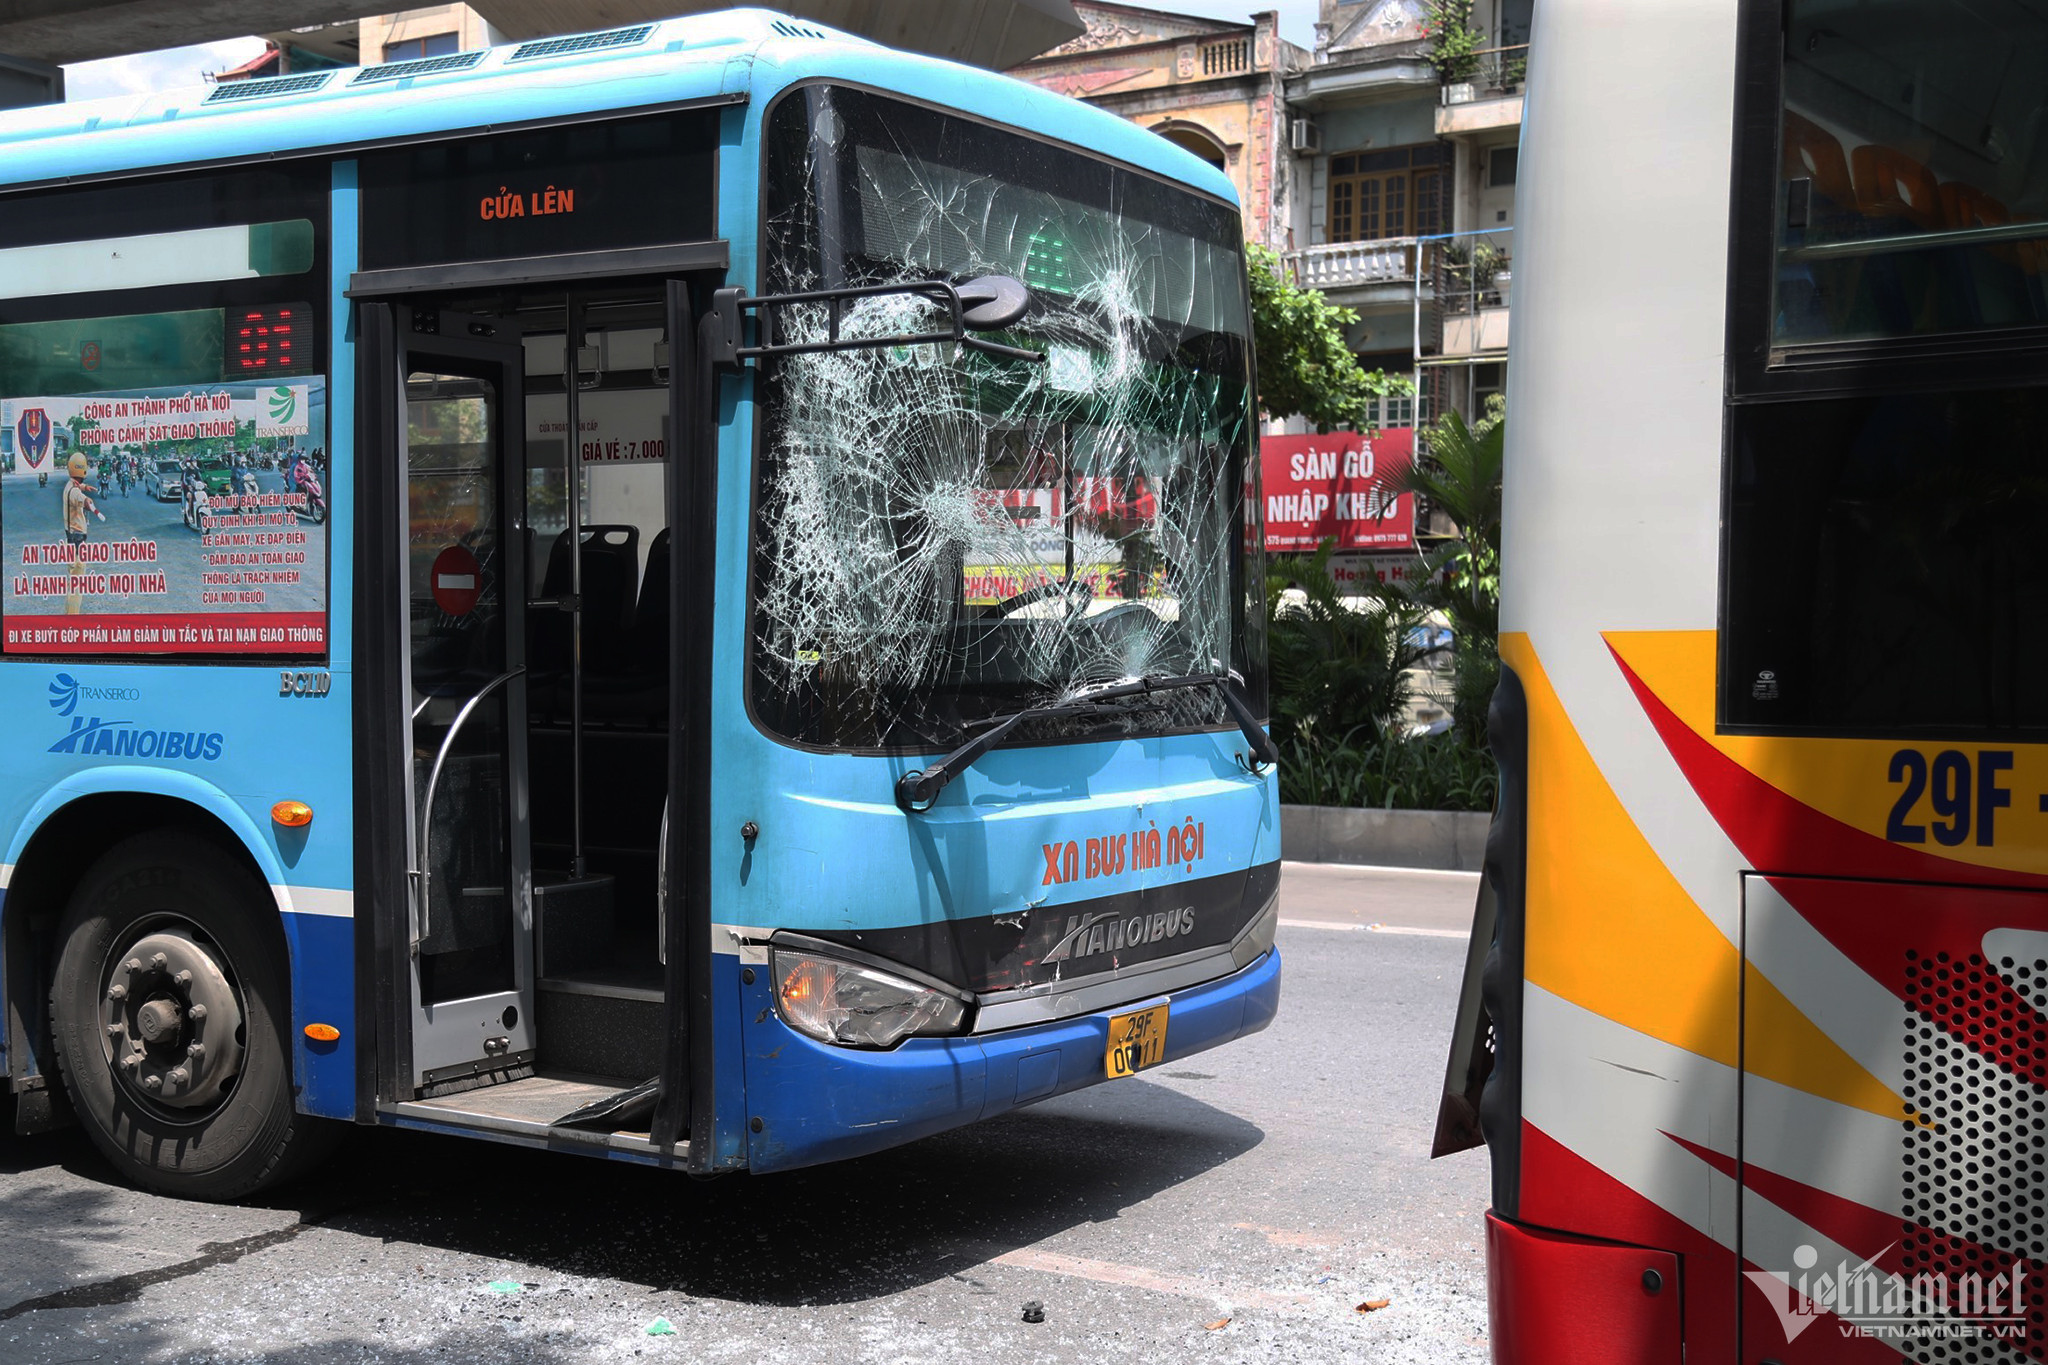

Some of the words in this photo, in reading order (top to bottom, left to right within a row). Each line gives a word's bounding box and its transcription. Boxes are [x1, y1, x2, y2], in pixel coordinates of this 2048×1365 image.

[480, 186, 525, 220] CỬA
[532, 185, 575, 216] LÊN
[240, 309, 291, 368] 01
[84, 401, 111, 420] CÔNG
[115, 402, 128, 418] AN
[132, 396, 166, 416] THÀNH
[169, 391, 191, 414] PHỐ
[194, 392, 209, 412] HÀ
[212, 390, 231, 413] NỘI
[80, 426, 115, 445] PHÒNG
[118, 424, 146, 442] CẢNH
[149, 421, 168, 441] SÁT
[172, 423, 195, 440] GIAO
[199, 418, 235, 438] THÔNG
[256, 426, 309, 438] TRANSERCO
[582, 438, 602, 461] GIÁ
[606, 437, 620, 460] VÉ
[1290, 448, 1336, 481] SÀN
[1344, 440, 1374, 479] GỖ
[209, 494, 223, 511] ĐỘI
[1268, 488, 1328, 528] NHẬP
[202, 516, 218, 528] QUY
[220, 515, 240, 530] ĐỊNH
[242, 515, 256, 527] KHI
[269, 510, 284, 525] MÔ
[22, 545, 39, 564] AN
[42, 540, 75, 564] TOÀN
[79, 542, 110, 562] GIAO
[112, 538, 156, 562] THÔNG
[202, 535, 212, 547] XE
[255, 533, 265, 545] XE
[267, 533, 284, 547] ĐẠP
[286, 531, 306, 547] ĐIỆN
[249, 553, 259, 565] AN
[261, 551, 283, 565] TOÀN
[285, 551, 305, 564] GIAO
[14, 572, 29, 596] LÀ
[33, 575, 67, 599] HẠNH
[70, 570, 106, 595] PHÚC
[109, 574, 135, 598] MỌI
[139, 569, 167, 594] NHÀ
[202, 571, 229, 585] THÔNG
[231, 570, 241, 584] LÀ
[243, 570, 270, 584] TRÁCH
[272, 570, 300, 586] NHIỆM
[221, 591, 237, 606] MỌI
[8, 629, 18, 643] ĐI
[20, 629, 32, 643] XE
[34, 626, 58, 643] BUÝT
[60, 625, 79, 643] GÓP
[82, 623, 109, 643] PHẦN
[111, 625, 131, 643] LÀM
[134, 624, 160, 643] GIẢM
[162, 624, 176, 643] ÙN
[179, 623, 198, 643] TẮC
[200, 624, 215, 643] VÀ
[217, 628, 233, 642] TAI
[236, 628, 257, 645] NẠN
[260, 627, 285, 642] GIAO
[287, 624, 323, 642] THÔNG
[80, 686, 140, 701] TRANSERCO
[47, 716, 224, 761] HANOIBUS
[1886, 749, 2013, 847] 29F
[1085, 834, 1126, 879] BUS
[1132, 820, 1161, 870] HÀ
[1167, 816, 1204, 874] NỘI
[1041, 906, 1195, 965] HANOIBUS
[1126, 1012, 1154, 1042] 29F
